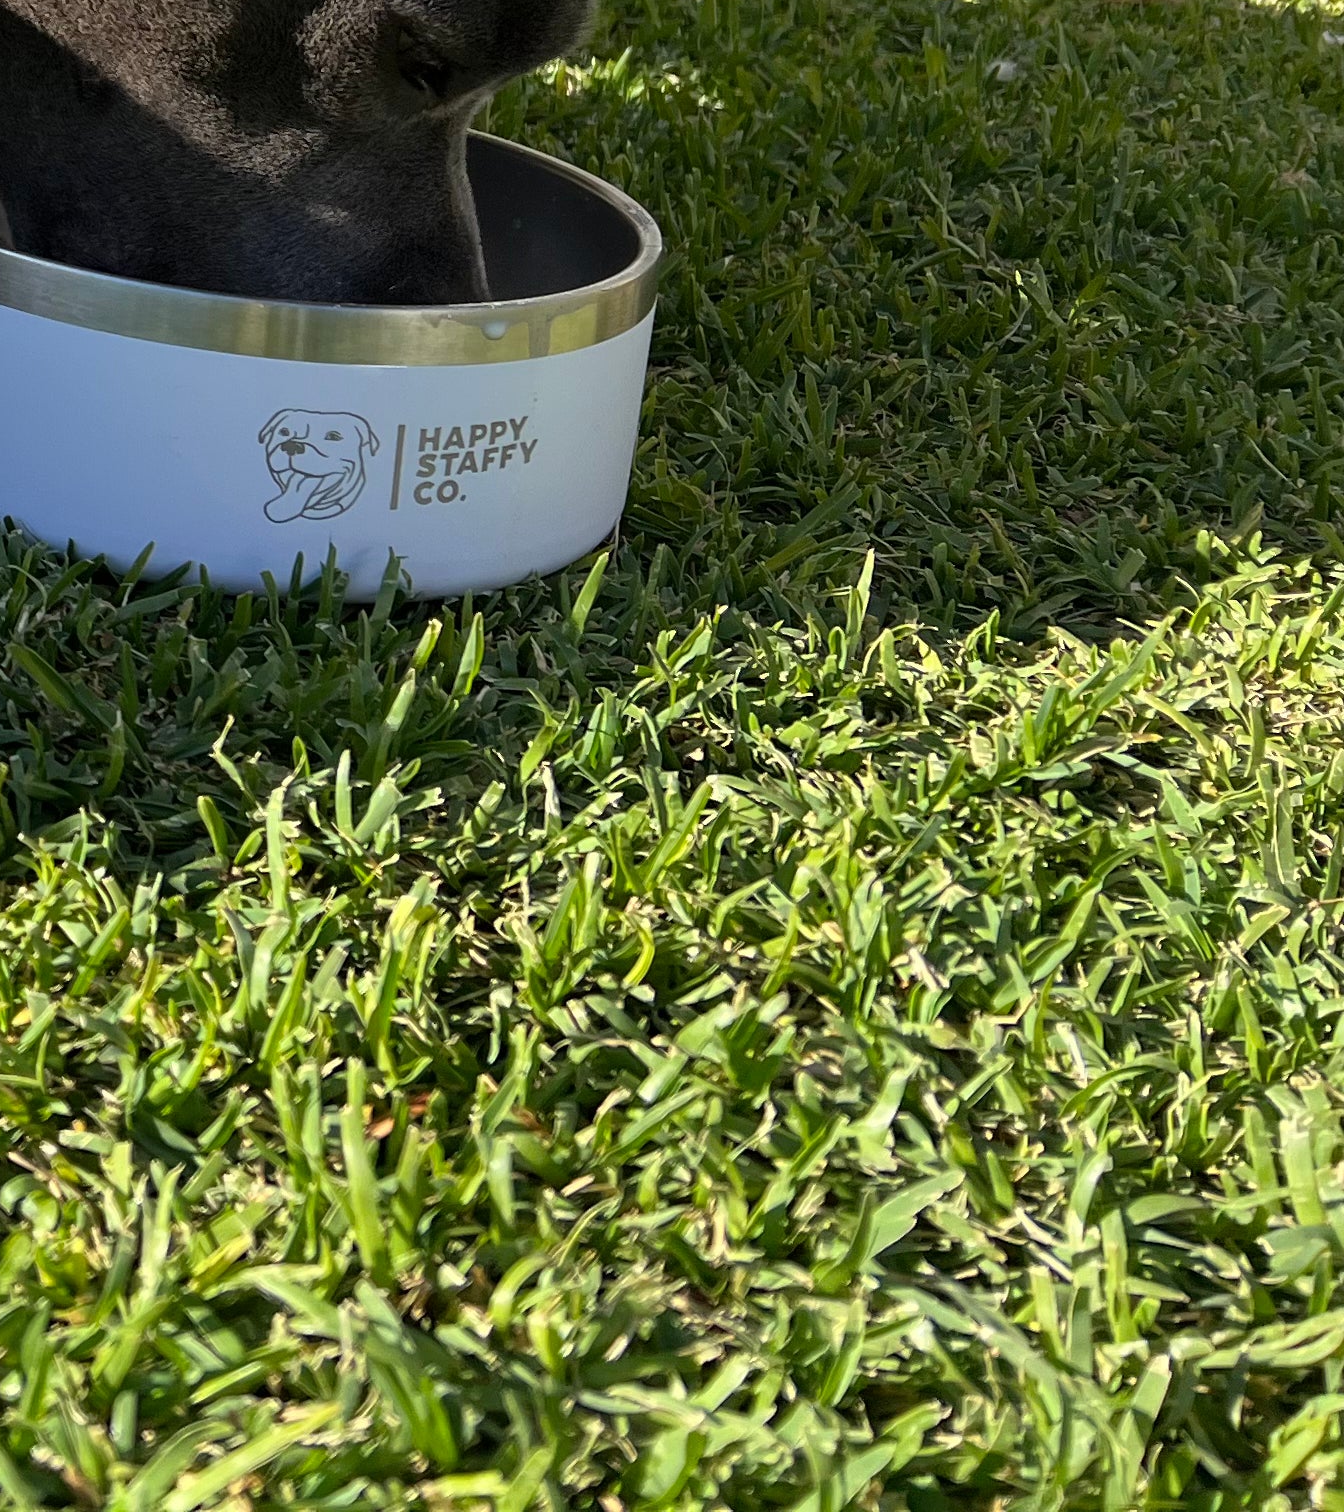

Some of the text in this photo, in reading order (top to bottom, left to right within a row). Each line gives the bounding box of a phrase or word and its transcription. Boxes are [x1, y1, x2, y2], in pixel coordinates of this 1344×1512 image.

[418, 416, 529, 453] HAPPY
[416, 439, 538, 478] STAFFY
[413, 480, 467, 505] CO.
